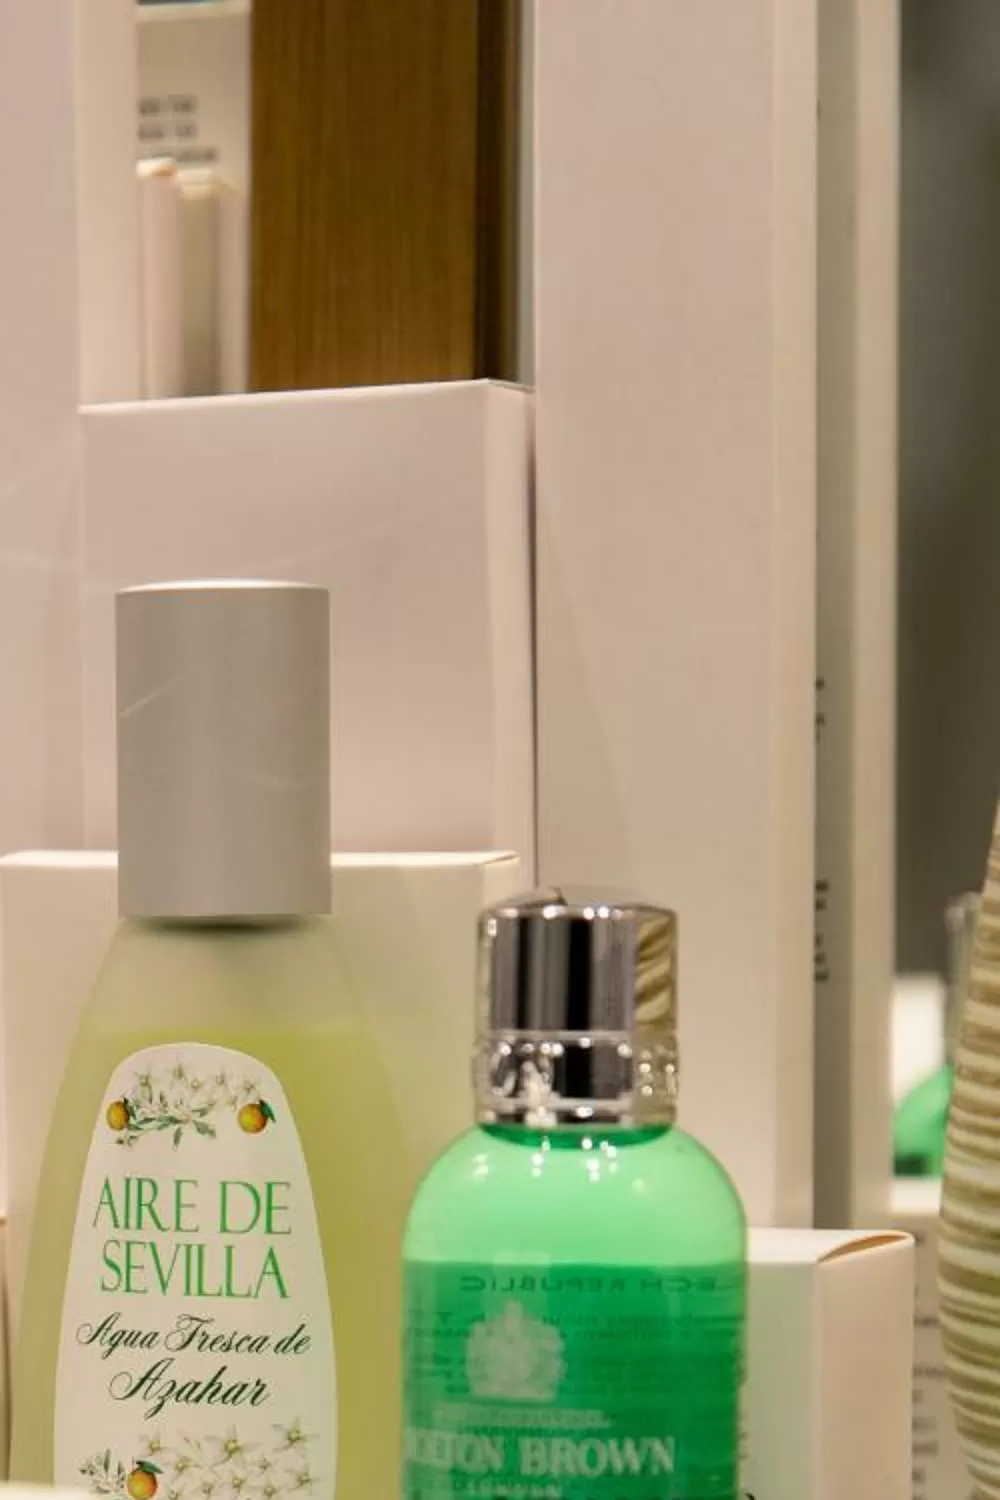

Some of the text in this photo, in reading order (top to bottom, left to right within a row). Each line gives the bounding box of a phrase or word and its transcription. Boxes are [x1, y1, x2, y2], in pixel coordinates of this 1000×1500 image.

[93, 1176, 293, 1235] AIRE DE
[100, 1239, 291, 1300] SEVILLA
[75, 1310, 311, 1361] Agua Fresca de
[107, 1355, 270, 1420] Azahar
[518, 1434, 676, 1479] BROWN
